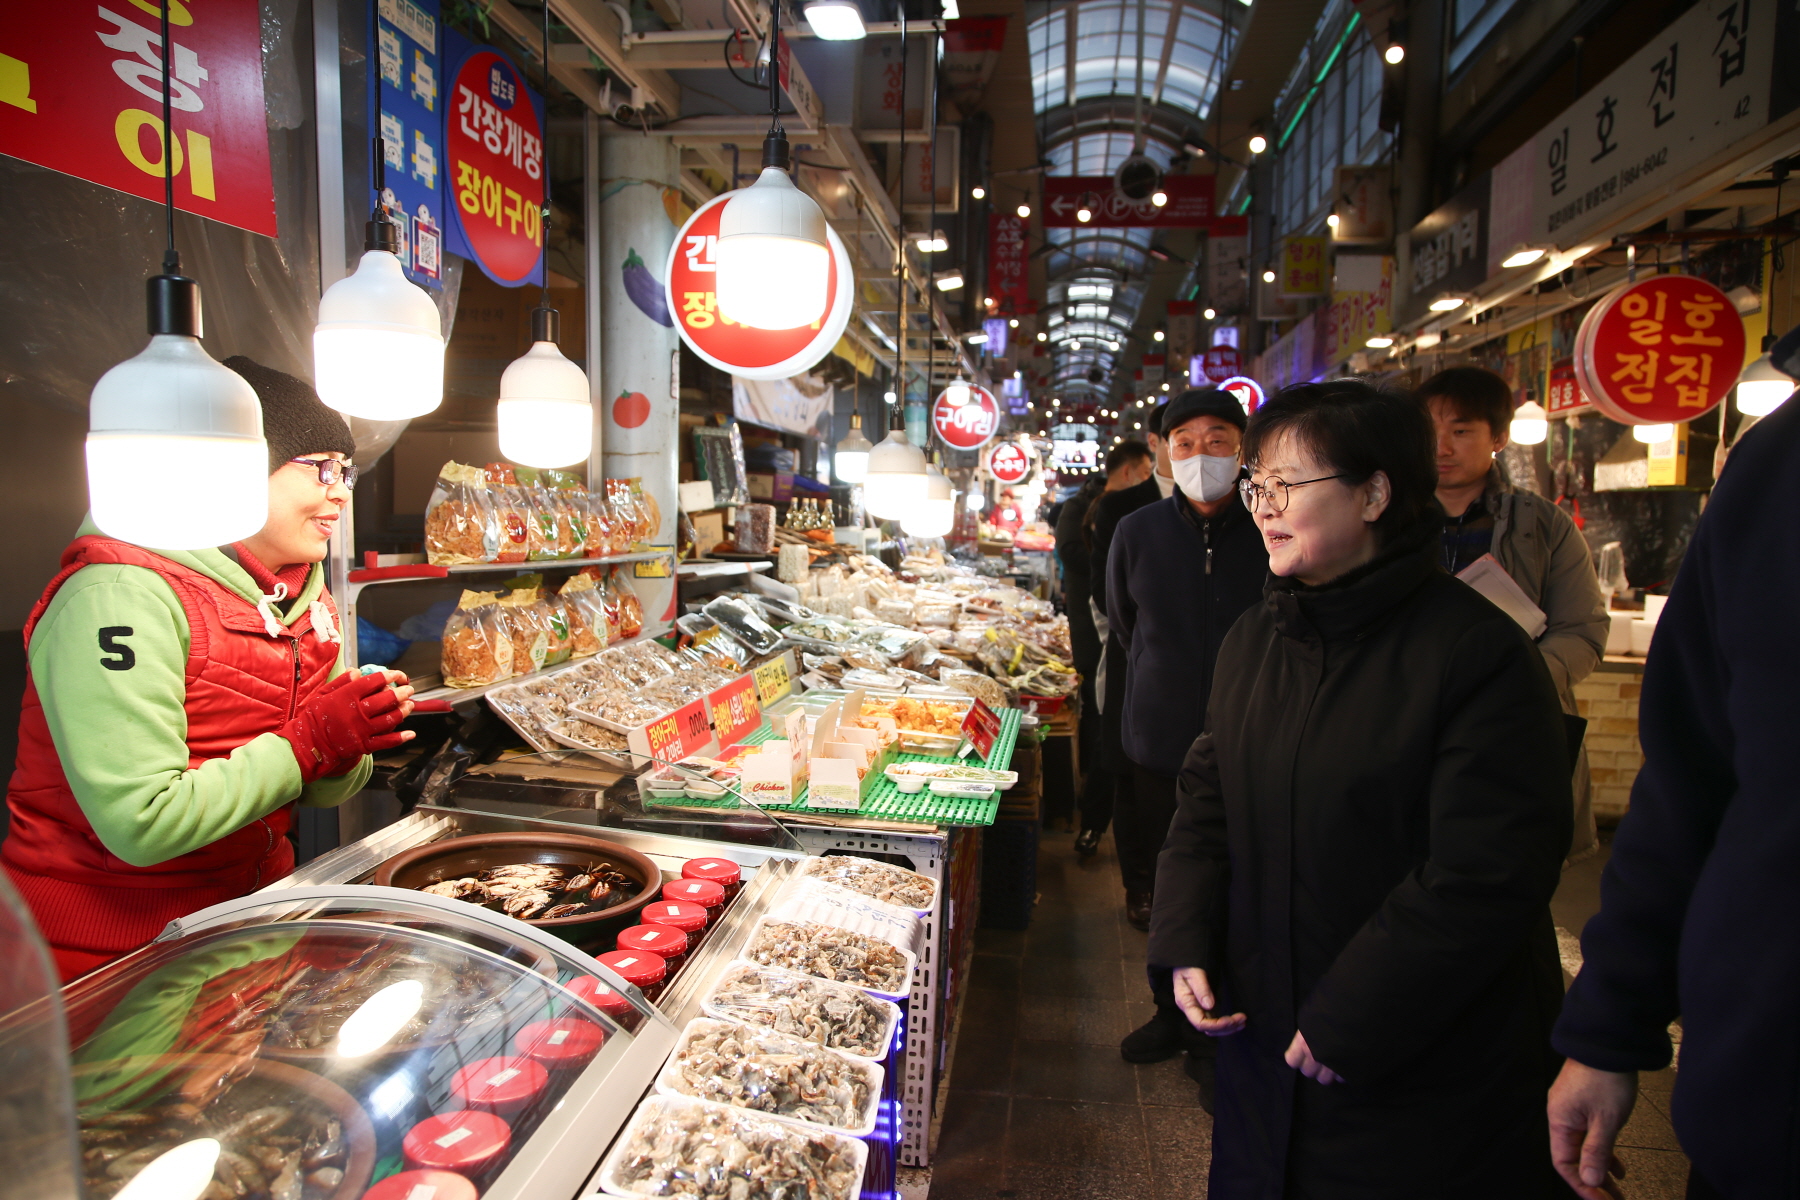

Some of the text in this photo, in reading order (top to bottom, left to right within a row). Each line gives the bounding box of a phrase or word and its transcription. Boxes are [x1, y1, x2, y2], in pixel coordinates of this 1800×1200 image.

[459, 83, 542, 180] 간장게장
[457, 159, 542, 248] 장어구이
[1620, 290, 1724, 347] 일호
[1611, 349, 1713, 410] 전집
[649, 715, 679, 749] 장어구이
[665, 738, 684, 762] 2마리
[752, 782, 785, 792] Chicken
